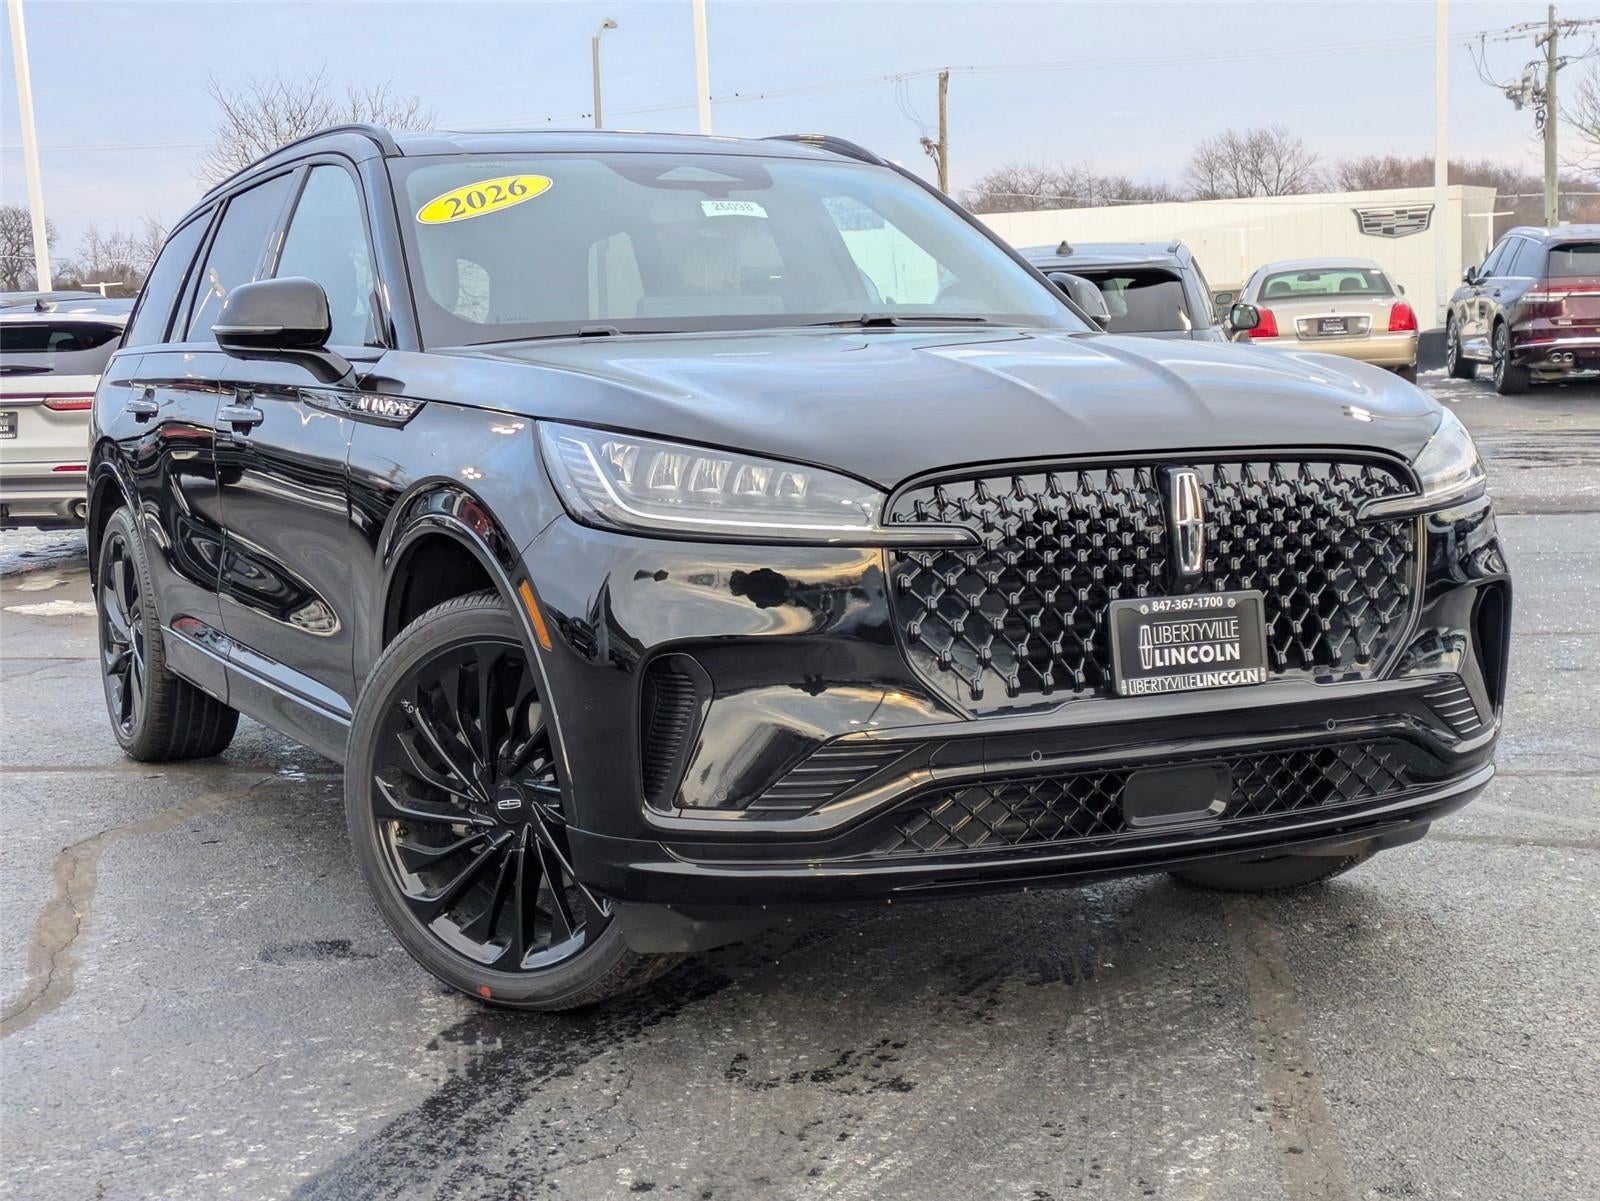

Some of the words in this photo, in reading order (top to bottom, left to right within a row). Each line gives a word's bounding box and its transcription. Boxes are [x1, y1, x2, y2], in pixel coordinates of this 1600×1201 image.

[444, 179, 528, 218] 2026
[712, 202, 754, 211] 26098
[1152, 597, 1223, 612] 847-367-1700
[1153, 620, 1239, 644] LIBERTYVILLE
[1154, 643, 1240, 667] LINCOLN
